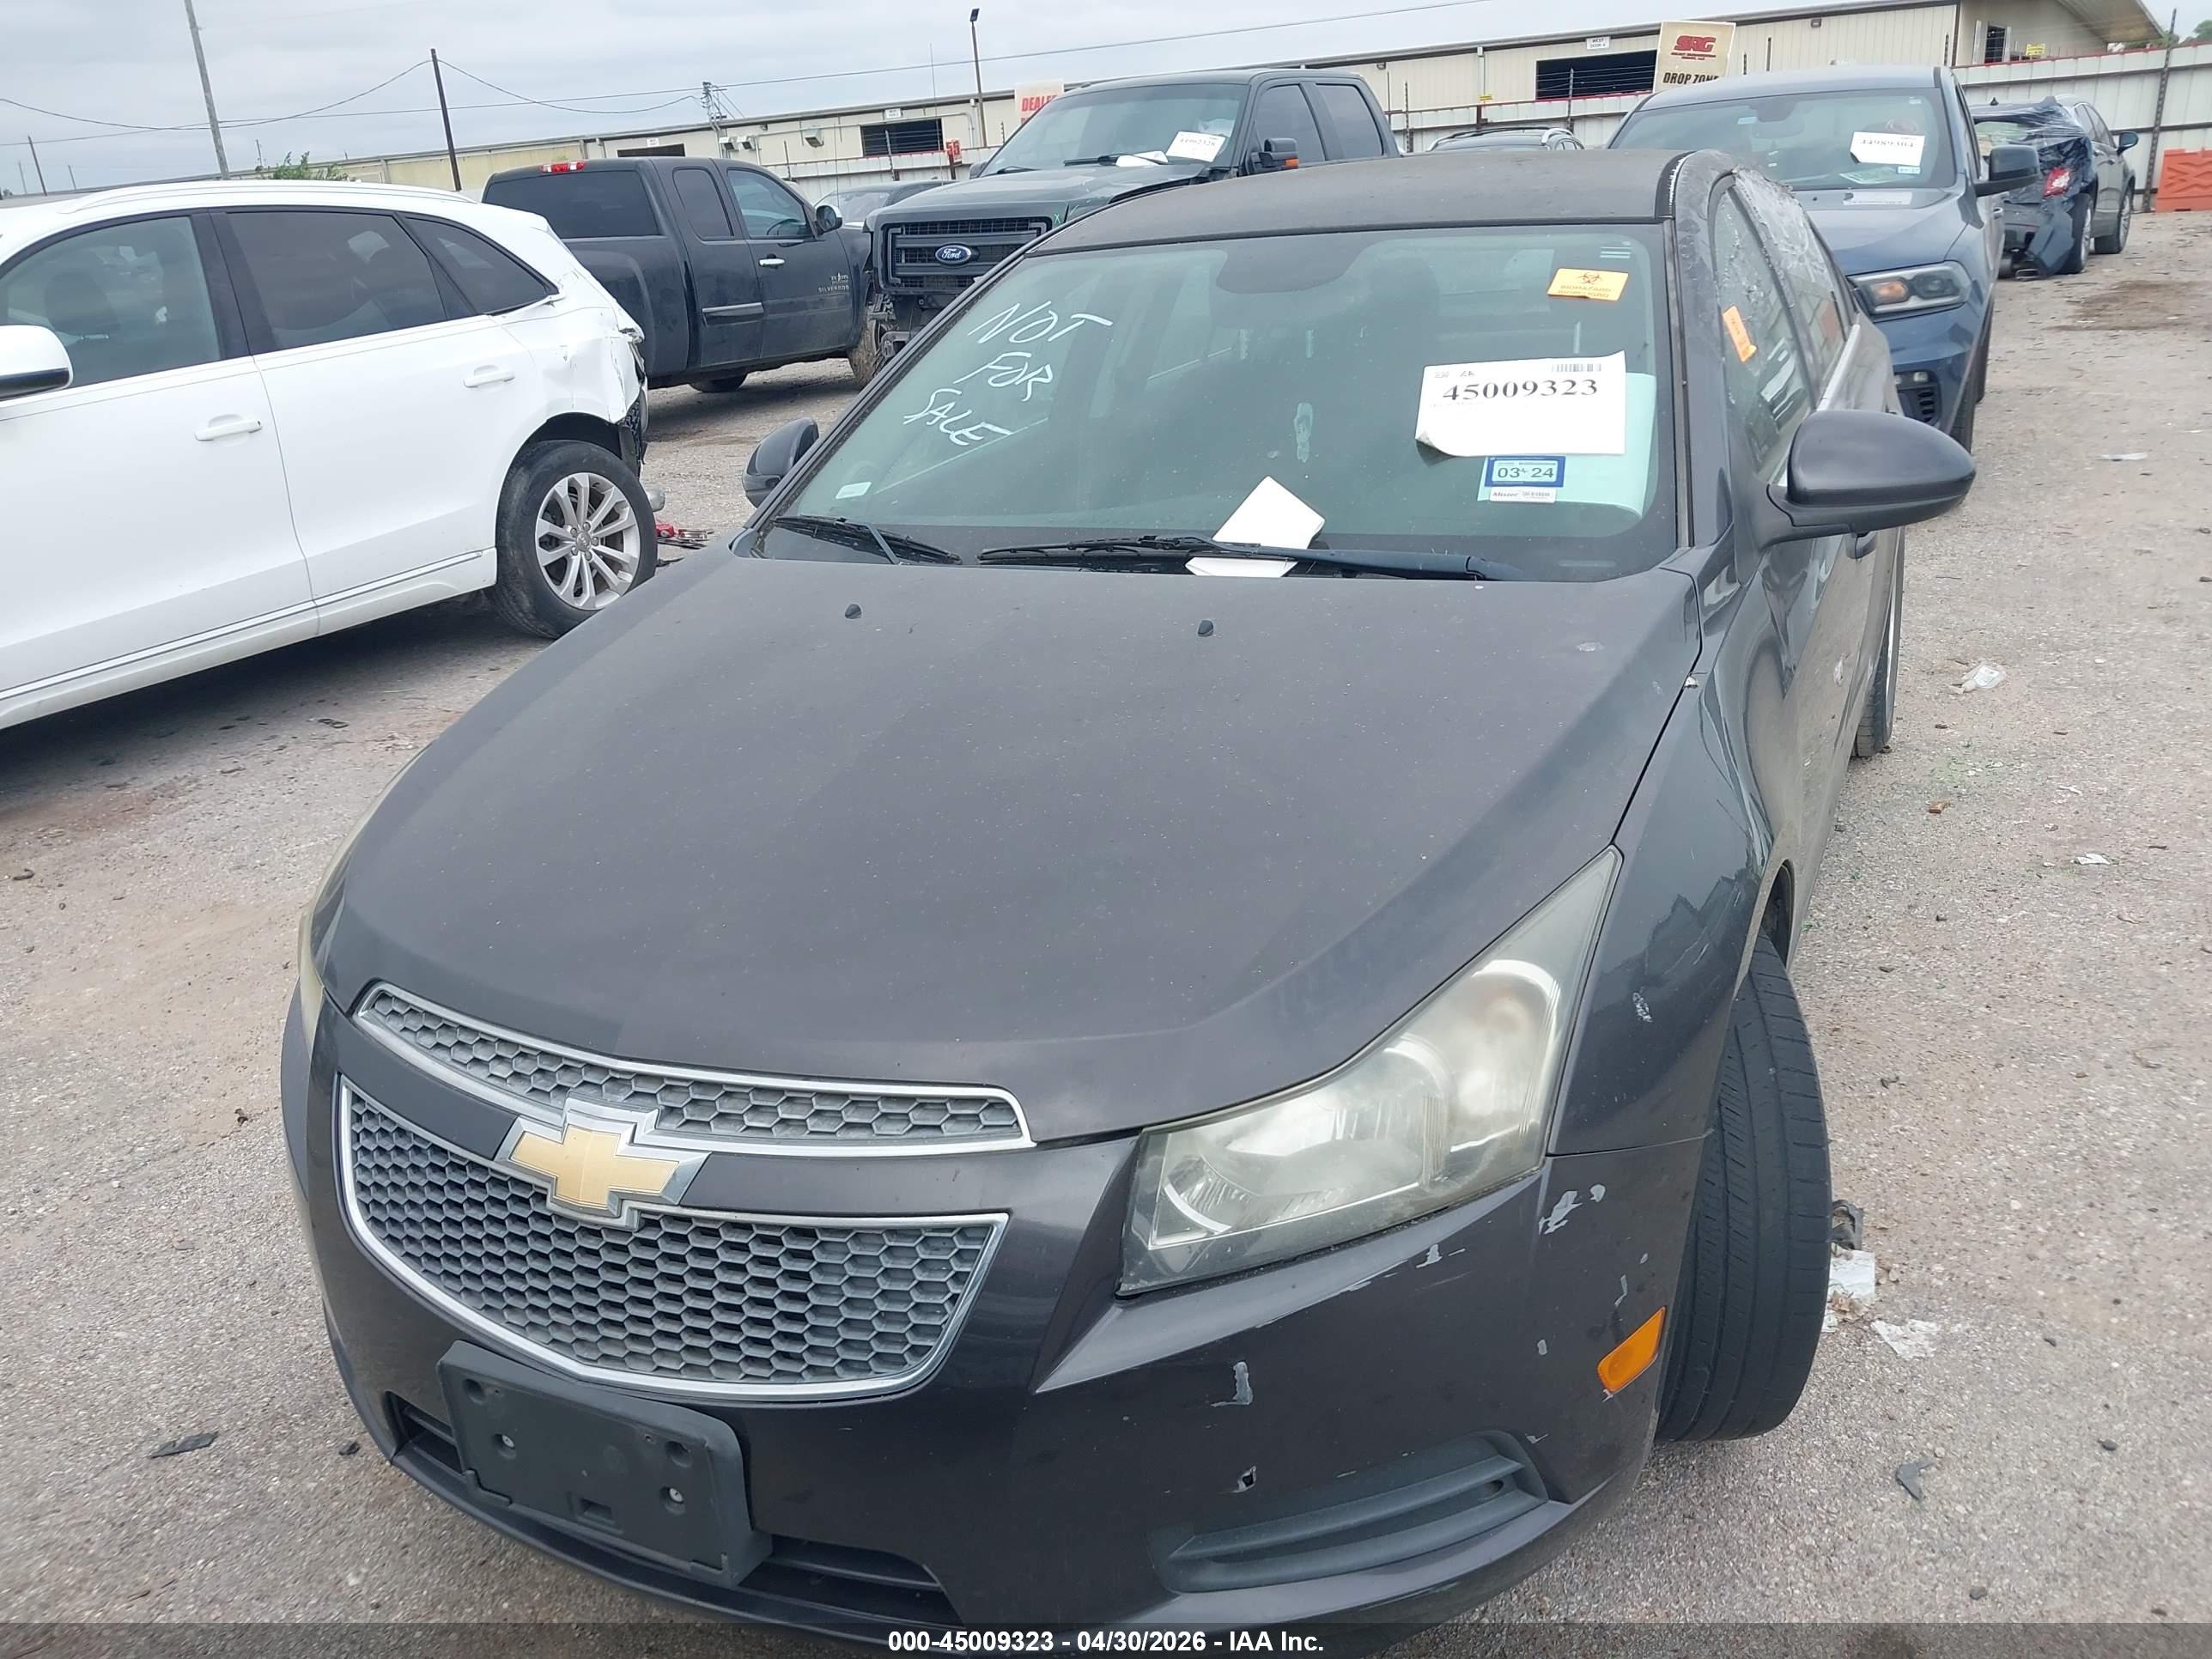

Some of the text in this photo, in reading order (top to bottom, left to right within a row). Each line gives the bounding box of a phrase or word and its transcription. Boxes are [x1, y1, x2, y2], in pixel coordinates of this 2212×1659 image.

[1674, 35, 1717, 52] SRG
[1662, 72, 1692, 85] DROP
[941, 248, 962, 259] Ford
[967, 301, 1114, 344] NOT
[953, 351, 1054, 402] FOR
[1443, 379, 1599, 401] 45009323
[902, 388, 1013, 446] SALE
[1497, 466, 1554, 478] 03 24
